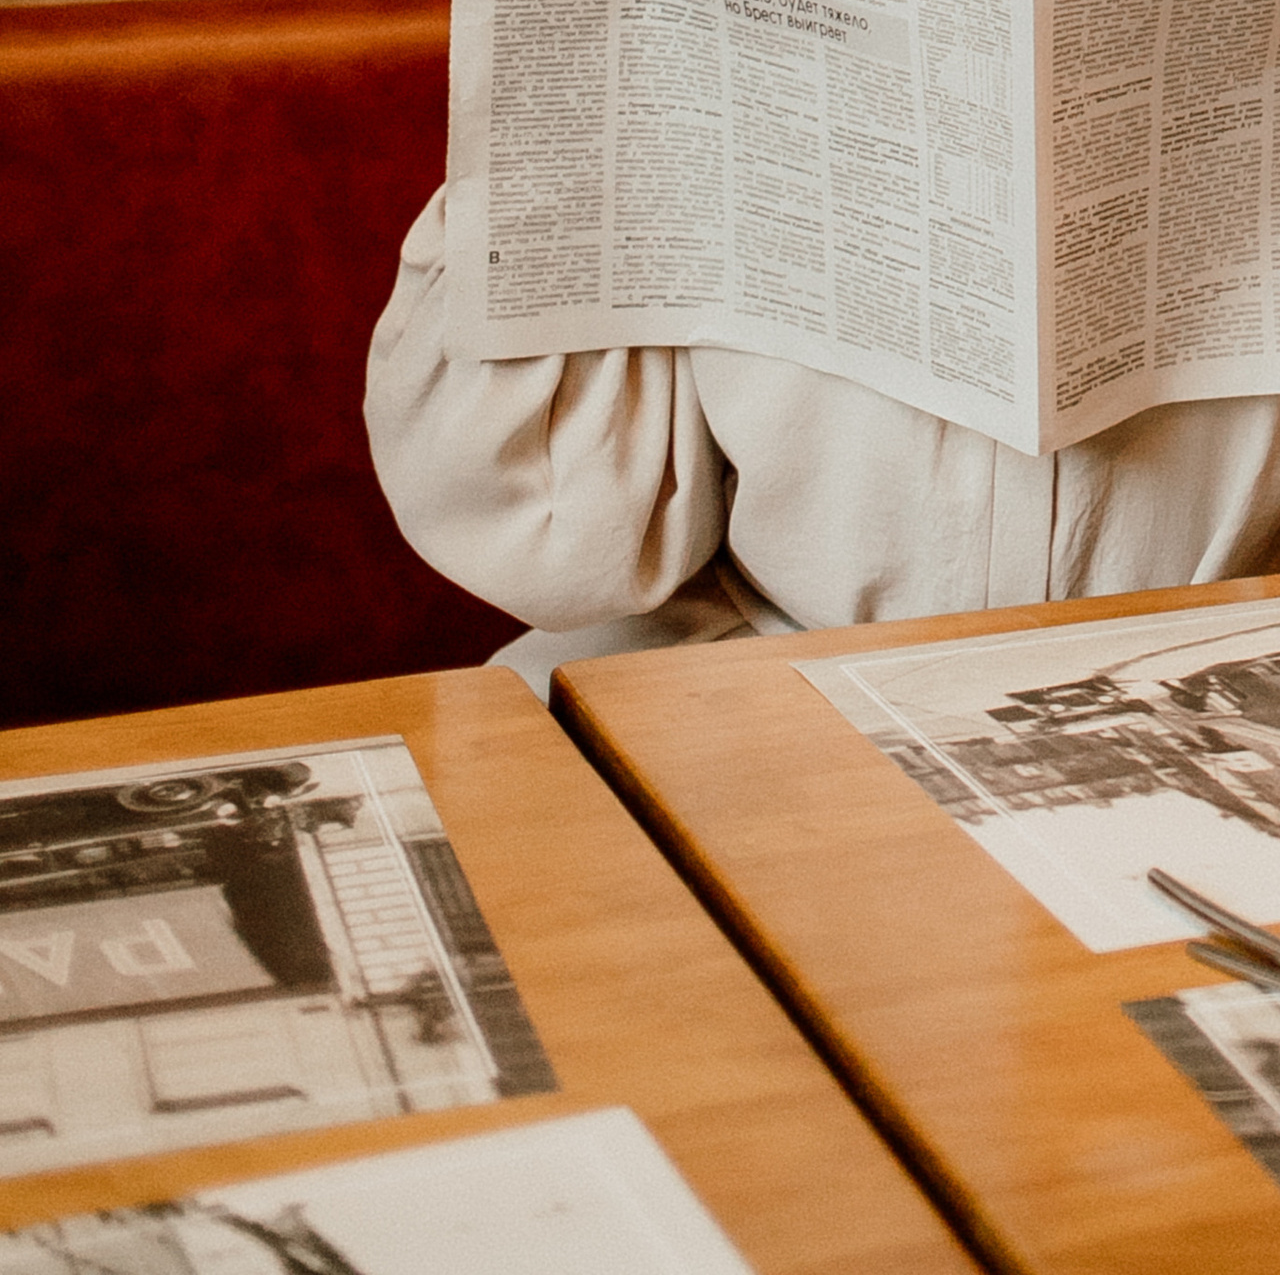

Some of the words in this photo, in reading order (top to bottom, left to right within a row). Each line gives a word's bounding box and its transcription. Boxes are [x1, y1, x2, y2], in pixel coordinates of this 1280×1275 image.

[724, 0, 741, 15] но
[743, 1, 783, 25] Брест
[787, 14, 847, 44] выиграет
[821, 4, 872, 34] тяжело,
